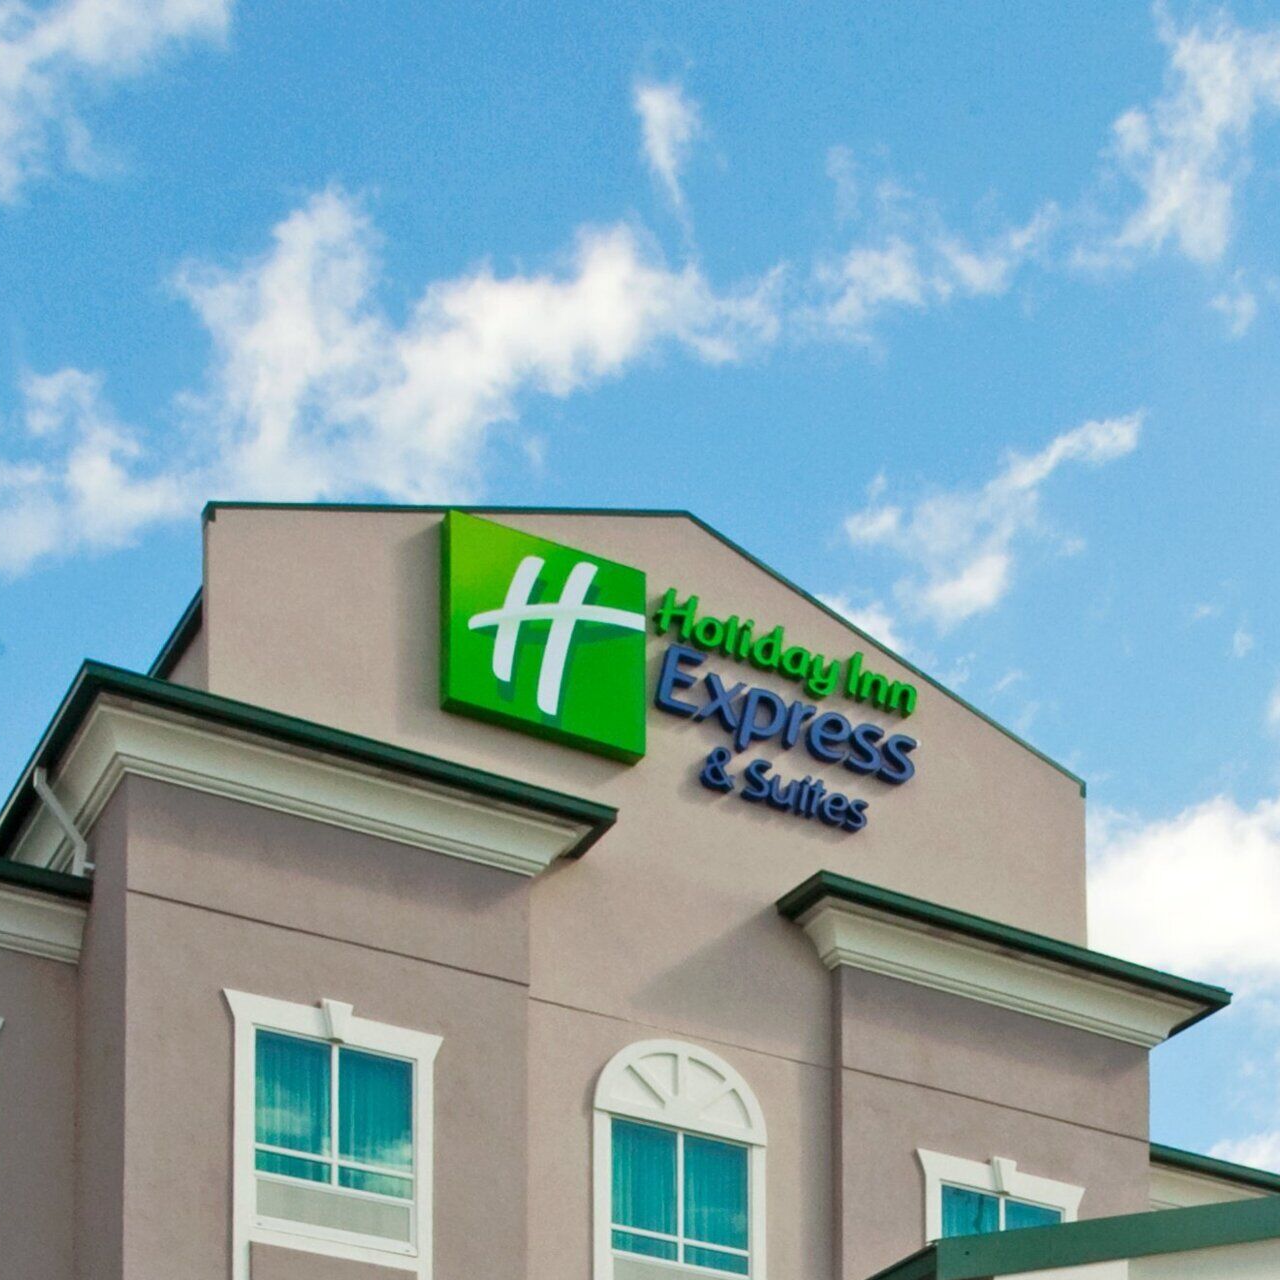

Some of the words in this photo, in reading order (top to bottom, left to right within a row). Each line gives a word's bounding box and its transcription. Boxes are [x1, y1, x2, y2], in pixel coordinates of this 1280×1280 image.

[653, 588, 841, 700] Holiday
[843, 651, 918, 718] Inn
[654, 643, 918, 785] Express
[699, 746, 735, 794] &
[740, 759, 869, 833] Suites
